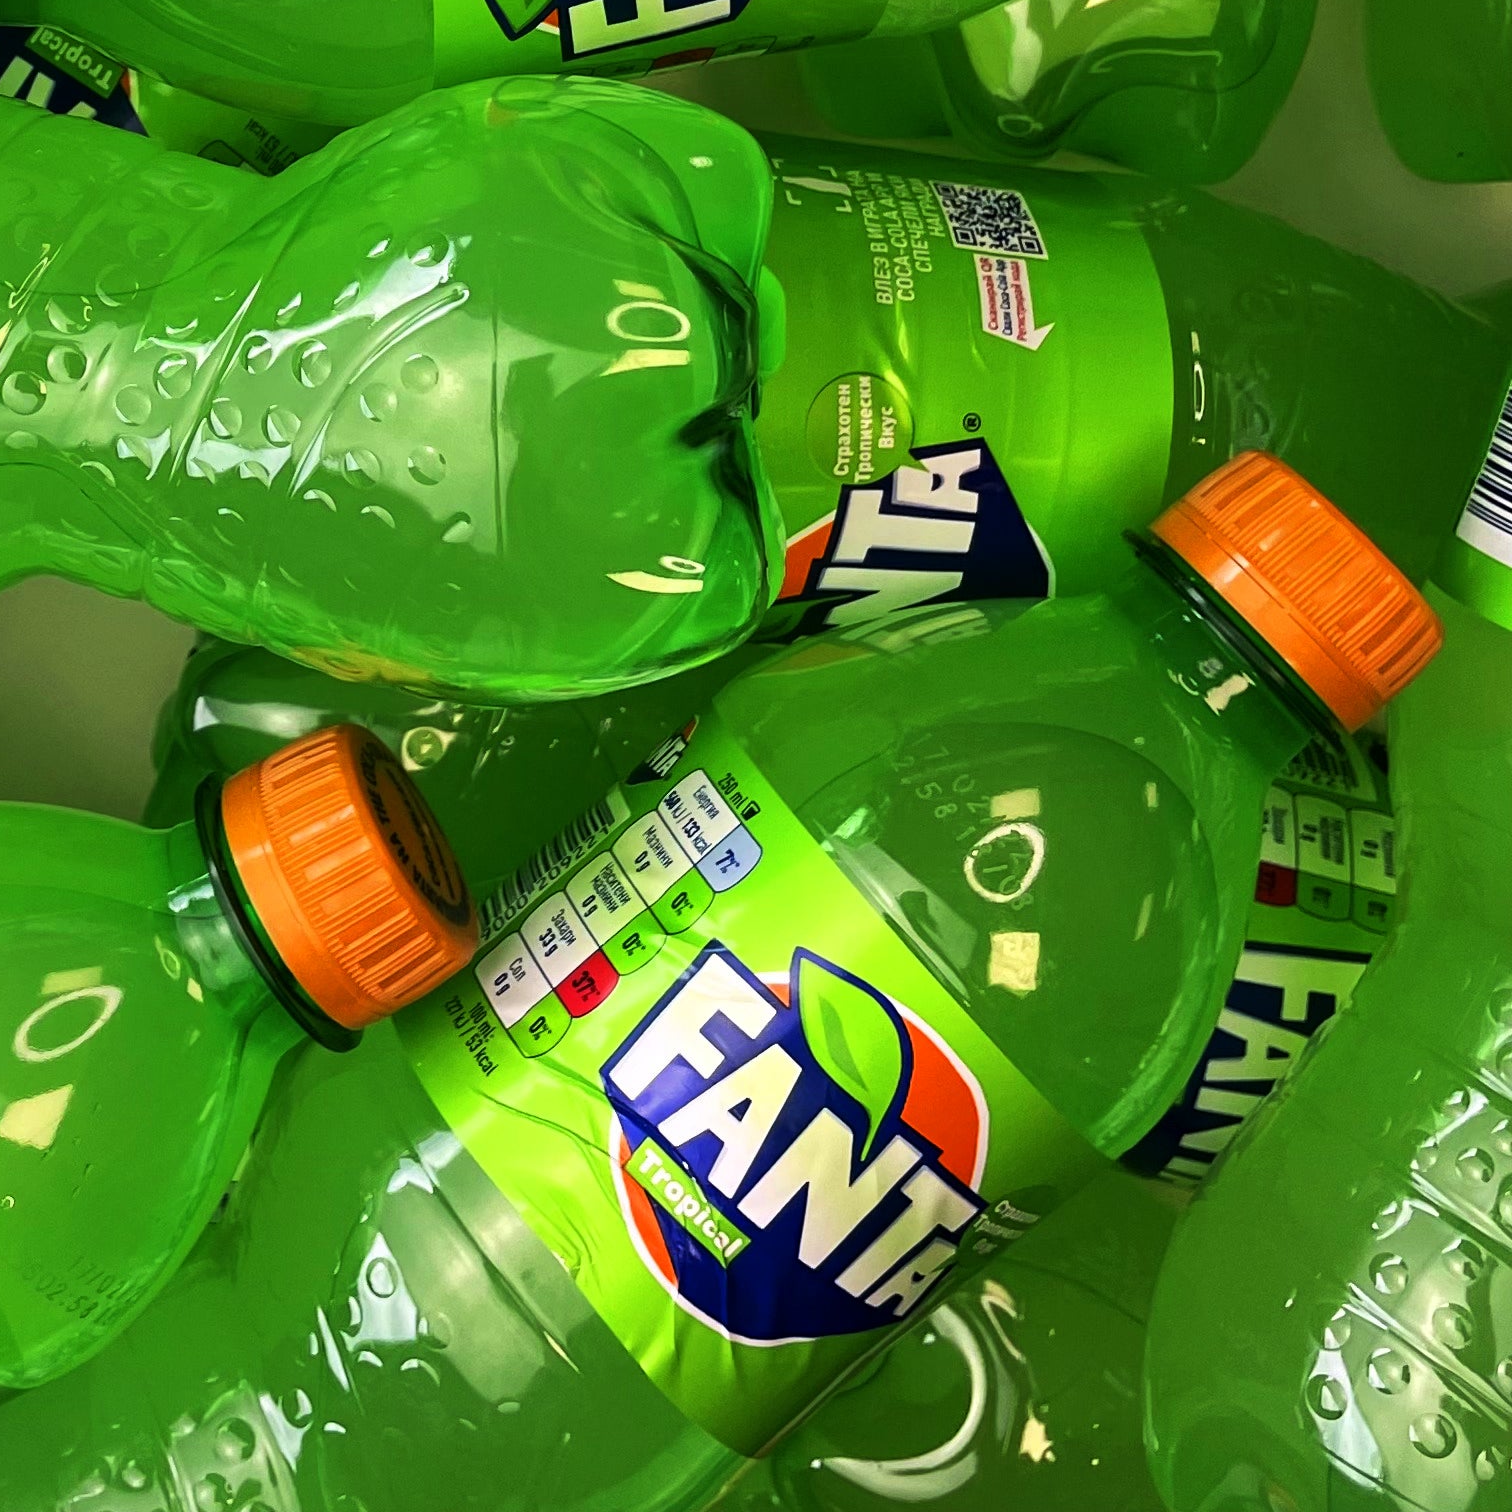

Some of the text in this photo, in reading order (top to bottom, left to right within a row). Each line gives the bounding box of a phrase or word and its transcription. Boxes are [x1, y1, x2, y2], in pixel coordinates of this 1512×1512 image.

[870, 242, 889, 253] В
[873, 256, 894, 305] ВЛЕЗ
[834, 384, 855, 477] Страхотен
[854, 375, 875, 484] Тропически
[878, 406, 897, 449] Вкус
[692, 784, 720, 820] Енергия
[717, 771, 749, 810] 250 ml
[634, 850, 649, 865] 0
[642, 824, 674, 869] Мазнини
[692, 831, 713, 856] kcal
[581, 893, 597, 909] 0
[600, 861, 632, 906] Наситени
[538, 927, 557, 949] 33
[551, 908, 577, 947] Захари
[494, 972, 509, 987] 0
[508, 956, 527, 983] Сол
[464, 1032, 484, 1053] 53
[473, 1046, 500, 1077] kcal
[609, 953, 980, 1317] FANTA
[638, 1146, 744, 1263] Tropical
